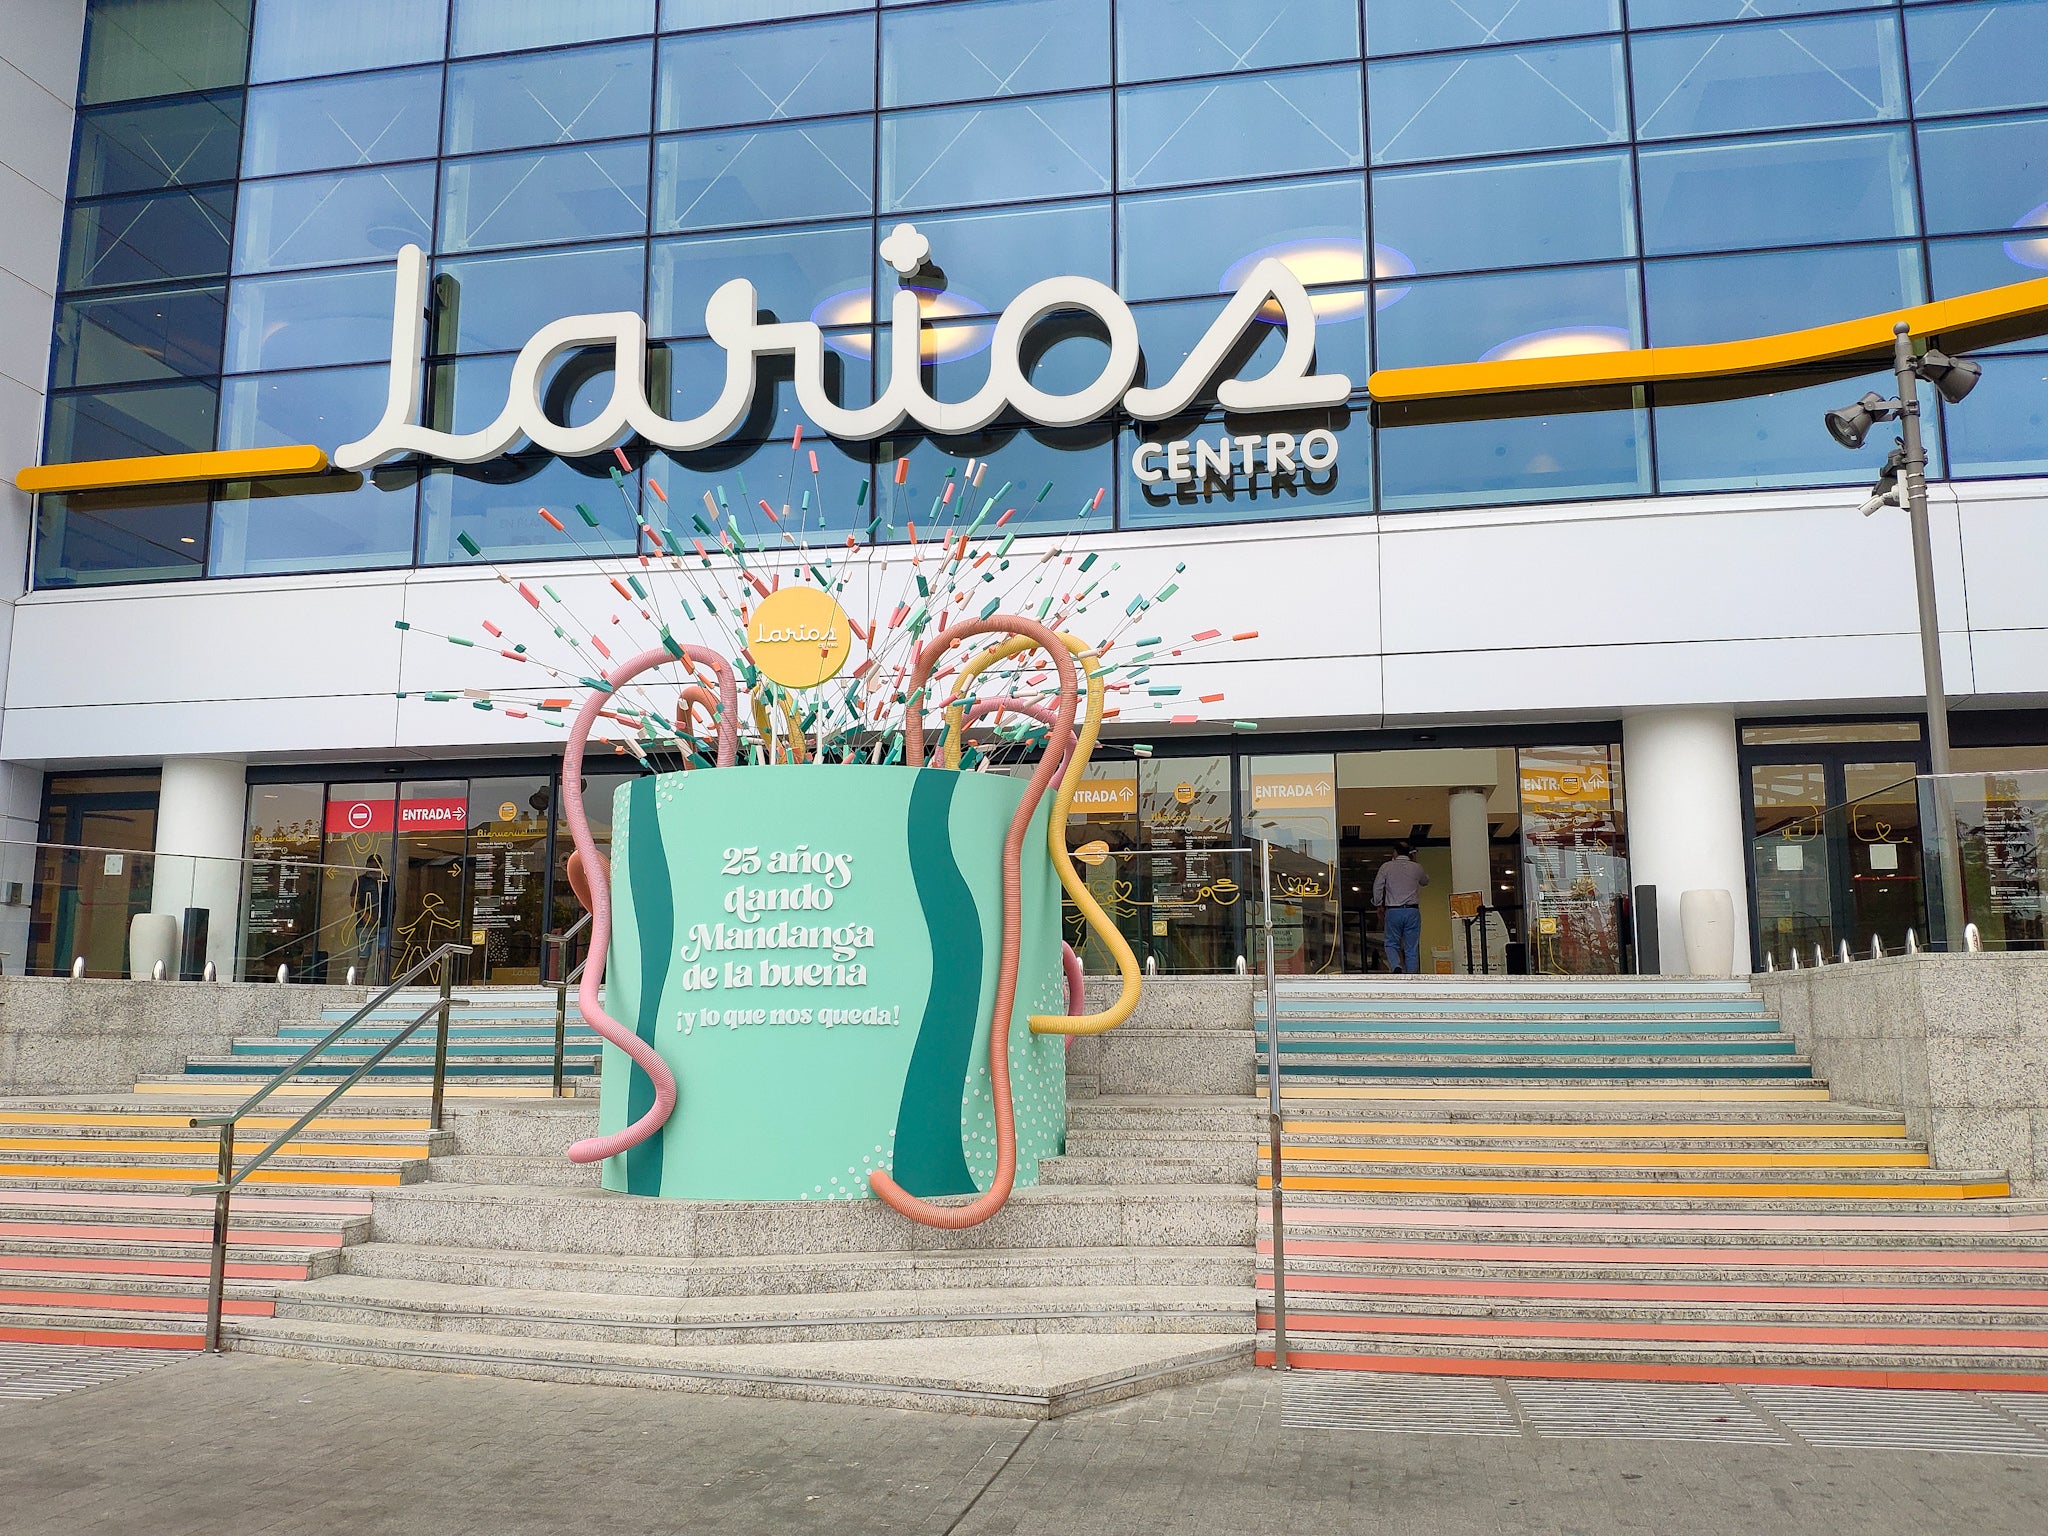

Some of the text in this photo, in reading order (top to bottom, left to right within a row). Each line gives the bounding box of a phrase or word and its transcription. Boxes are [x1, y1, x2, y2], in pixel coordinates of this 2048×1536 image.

[334, 223, 1350, 470] Larios
[1132, 429, 1338, 485] CENTRO
[755, 624, 837, 643] Larios
[1255, 784, 1314, 799] ENTRADA
[402, 808, 452, 821] ENTRADA
[721, 844, 853, 889] 25 años
[724, 883, 834, 924] dando
[680, 922, 875, 962] Mandanga
[682, 960, 868, 992] de la buena
[676, 1005, 900, 1035] ¡y lo que nos queda!
